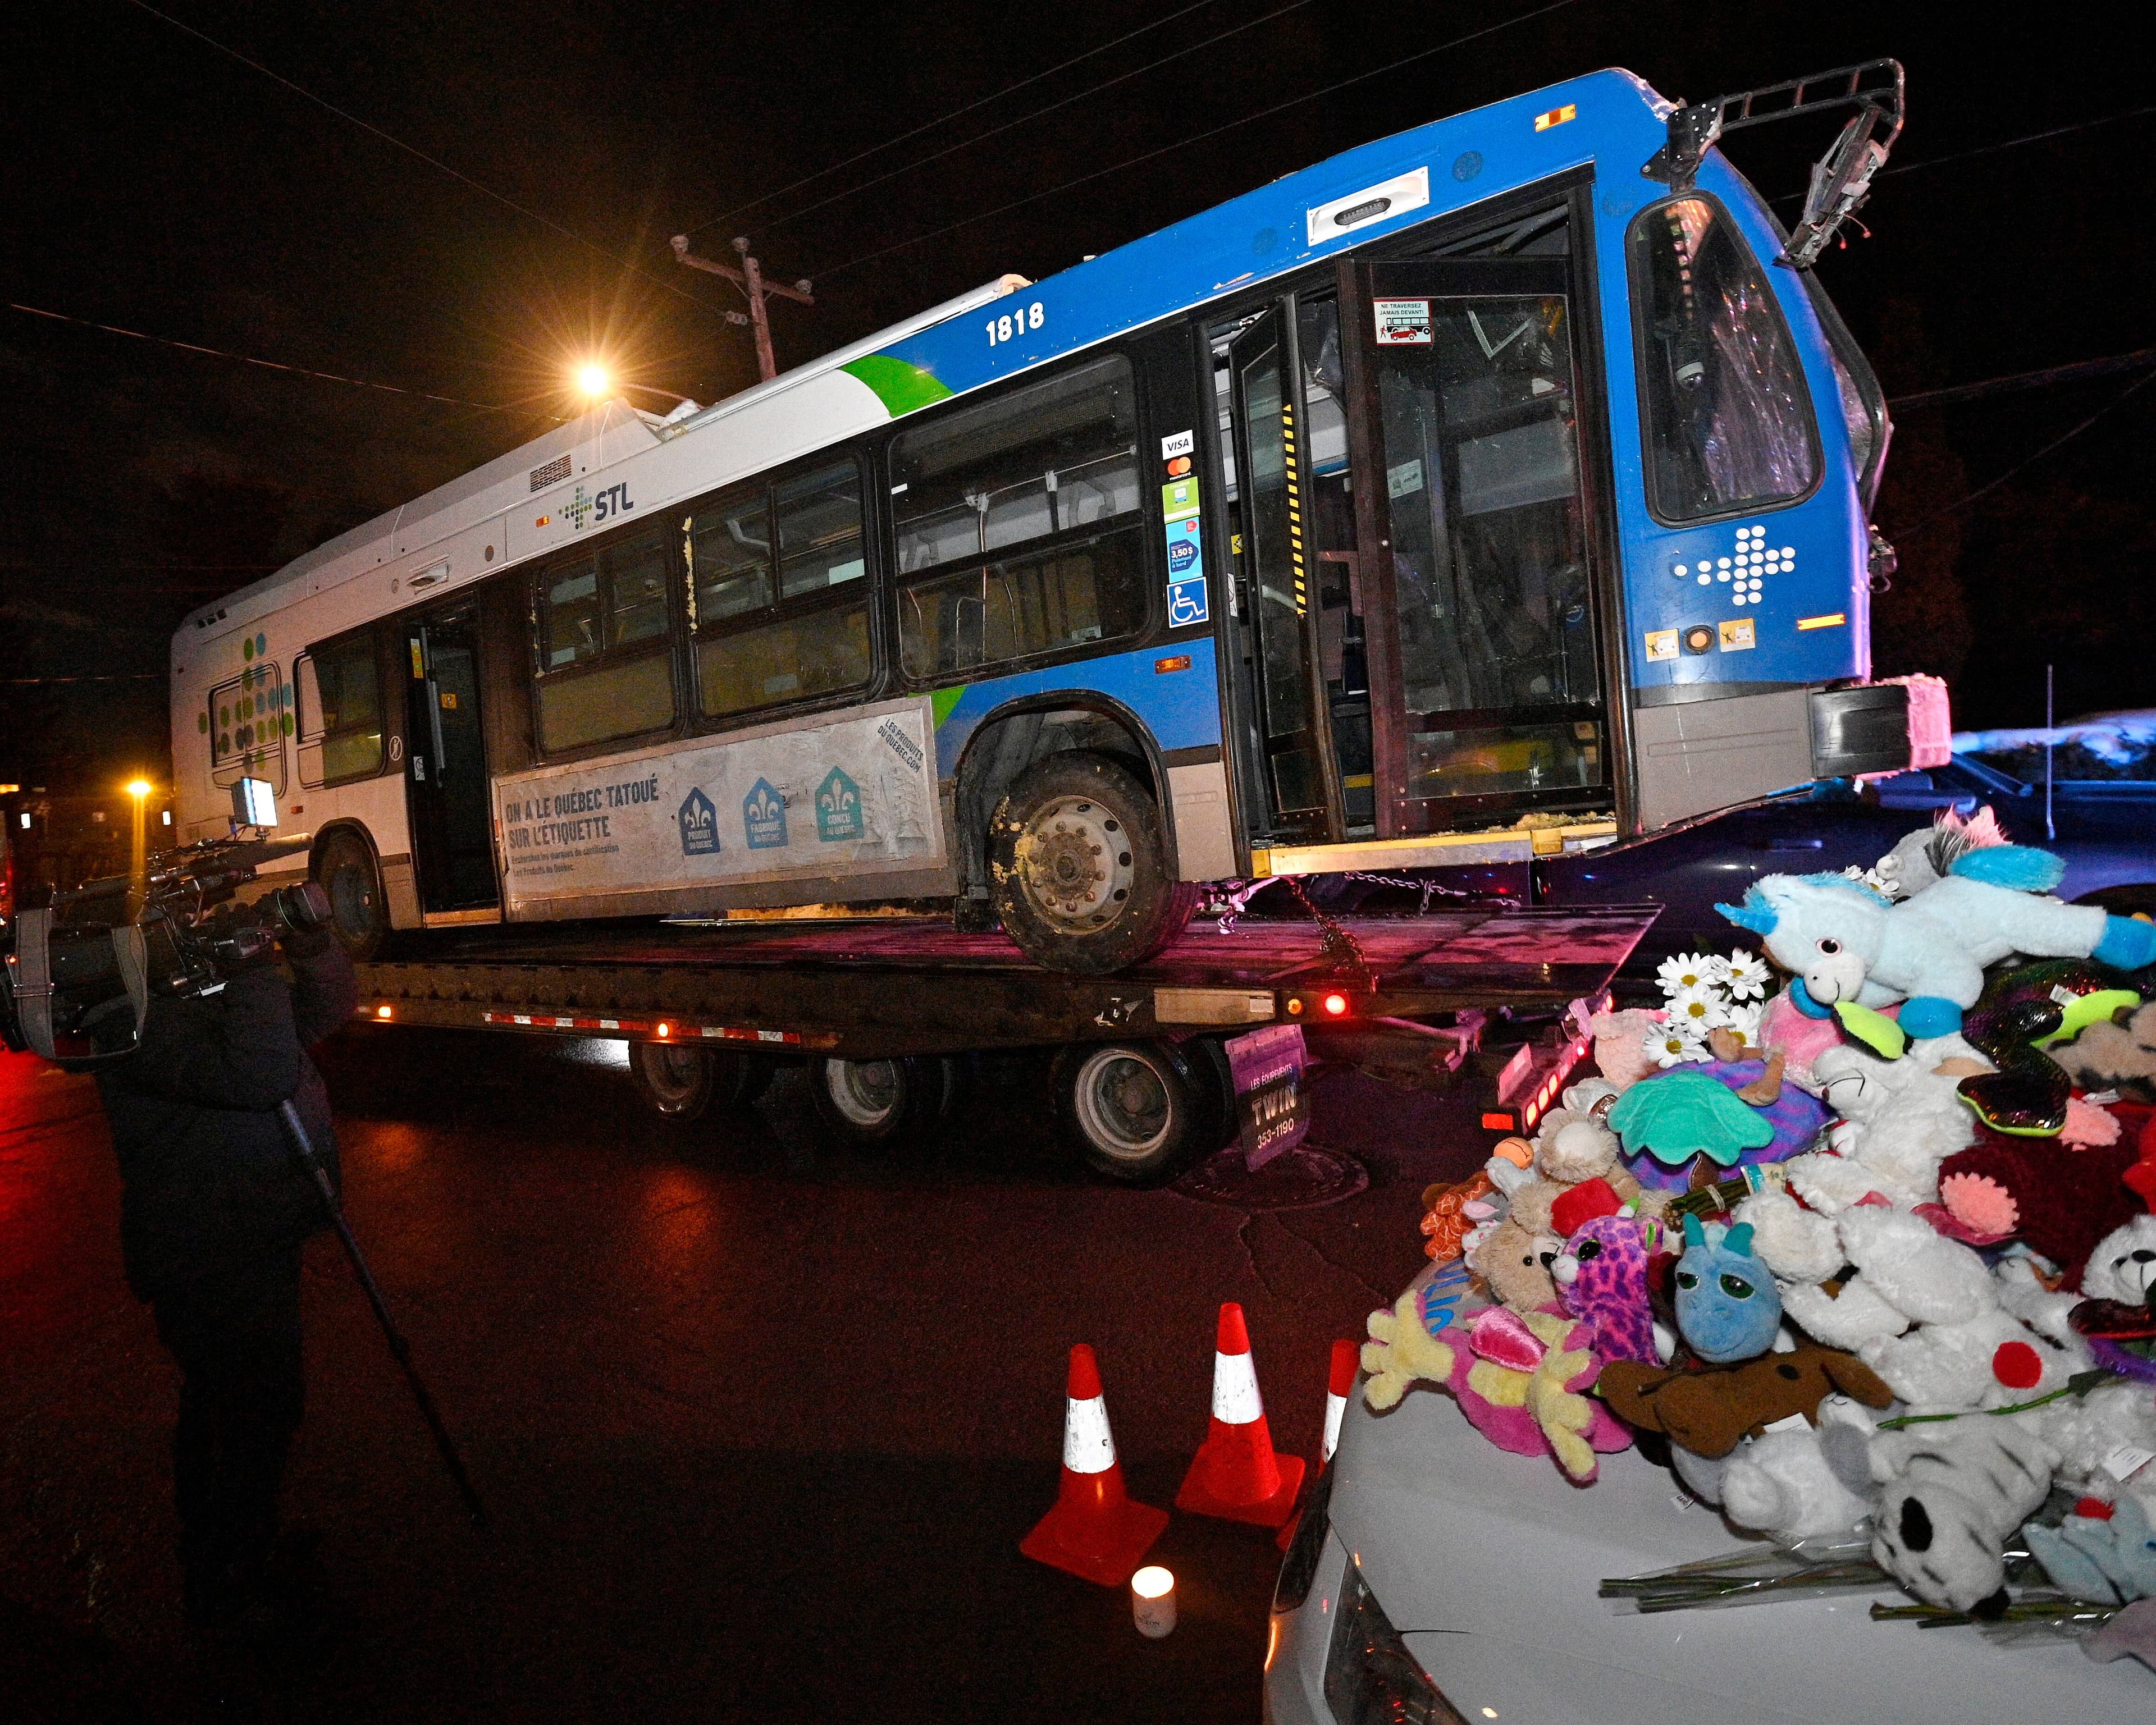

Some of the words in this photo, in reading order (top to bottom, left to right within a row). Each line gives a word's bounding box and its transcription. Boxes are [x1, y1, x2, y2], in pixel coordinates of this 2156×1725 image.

[985, 301, 1044, 347] 1818
[1167, 438, 1189, 451] VISA
[595, 482, 634, 521] STL
[878, 725, 888, 737] DU
[885, 719, 897, 733] LES
[896, 729, 924, 761] PRODUITS
[506, 803, 521, 823] ON
[526, 800, 533, 821] A
[536, 797, 550, 818] LE
[554, 787, 602, 818] QUÉBEC
[606, 773, 659, 808] TATOUÉ
[509, 827, 531, 849] SUR
[533, 816, 610, 845] L'ÉTIQUETTE
[1250, 1077, 1260, 1091] LES
[1261, 1063, 1293, 1086] ÉQUIPEMENTS
[1251, 1082, 1297, 1126] TWIN
[1257, 1118, 1294, 1150] 353-1190
